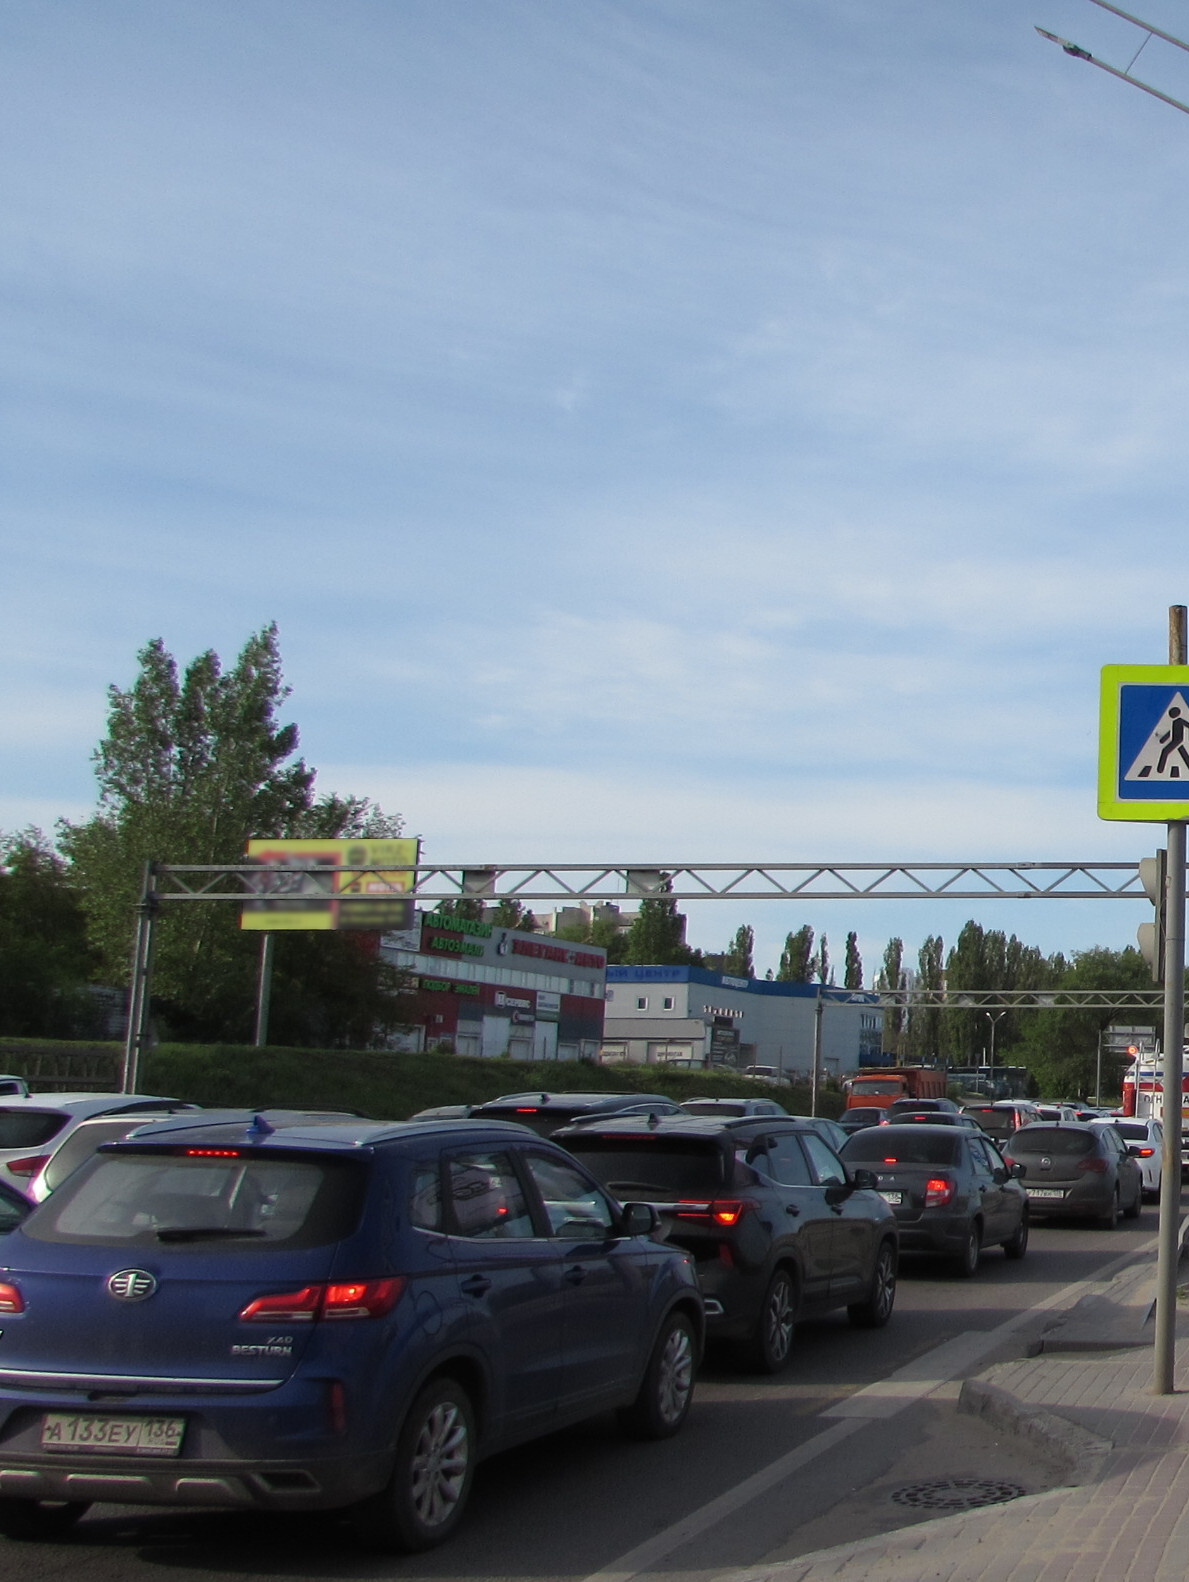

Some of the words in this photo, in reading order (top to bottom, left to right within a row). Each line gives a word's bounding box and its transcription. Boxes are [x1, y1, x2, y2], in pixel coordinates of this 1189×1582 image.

[424, 913, 493, 939] АВТОМАГАЗИН
[231, 1345, 292, 1356] BESTURN
[146, 1419, 177, 1438] 136
